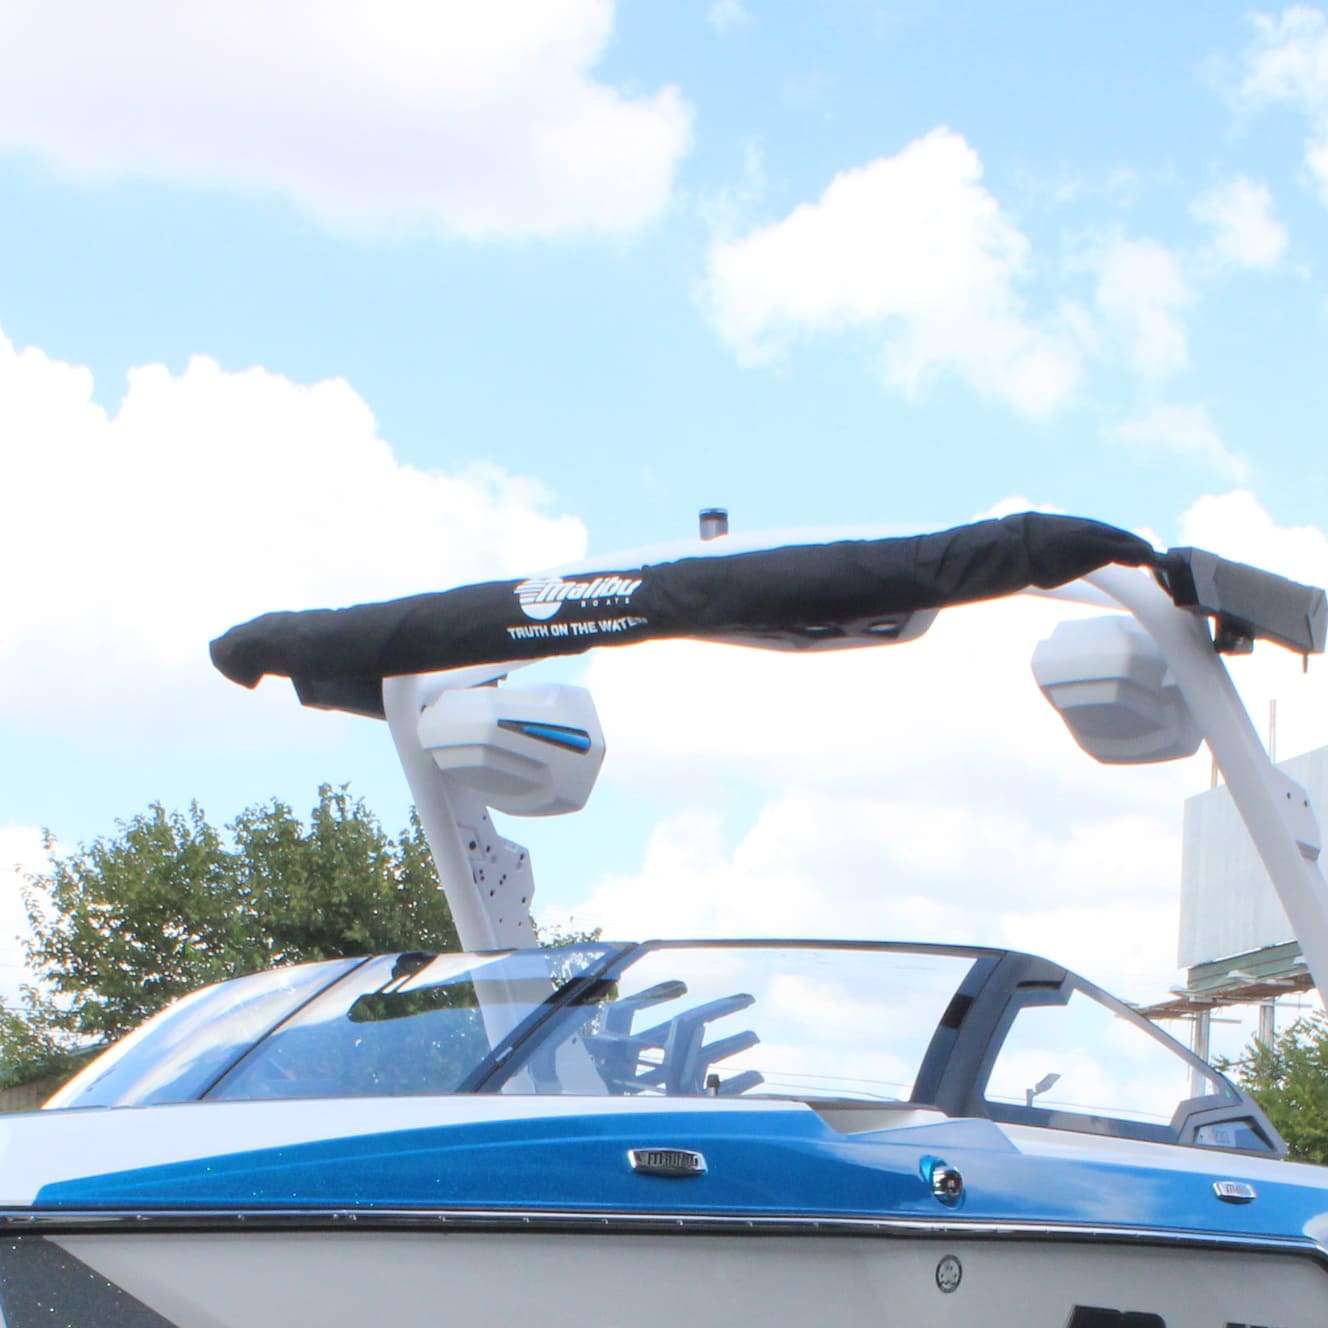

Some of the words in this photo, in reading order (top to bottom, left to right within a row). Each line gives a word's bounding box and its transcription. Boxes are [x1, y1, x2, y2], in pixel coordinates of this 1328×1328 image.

[581, 597, 630, 608] BOATS
[507, 626, 549, 640] TRUTH
[550, 624, 568, 637] ON
[570, 620, 597, 637] THE
